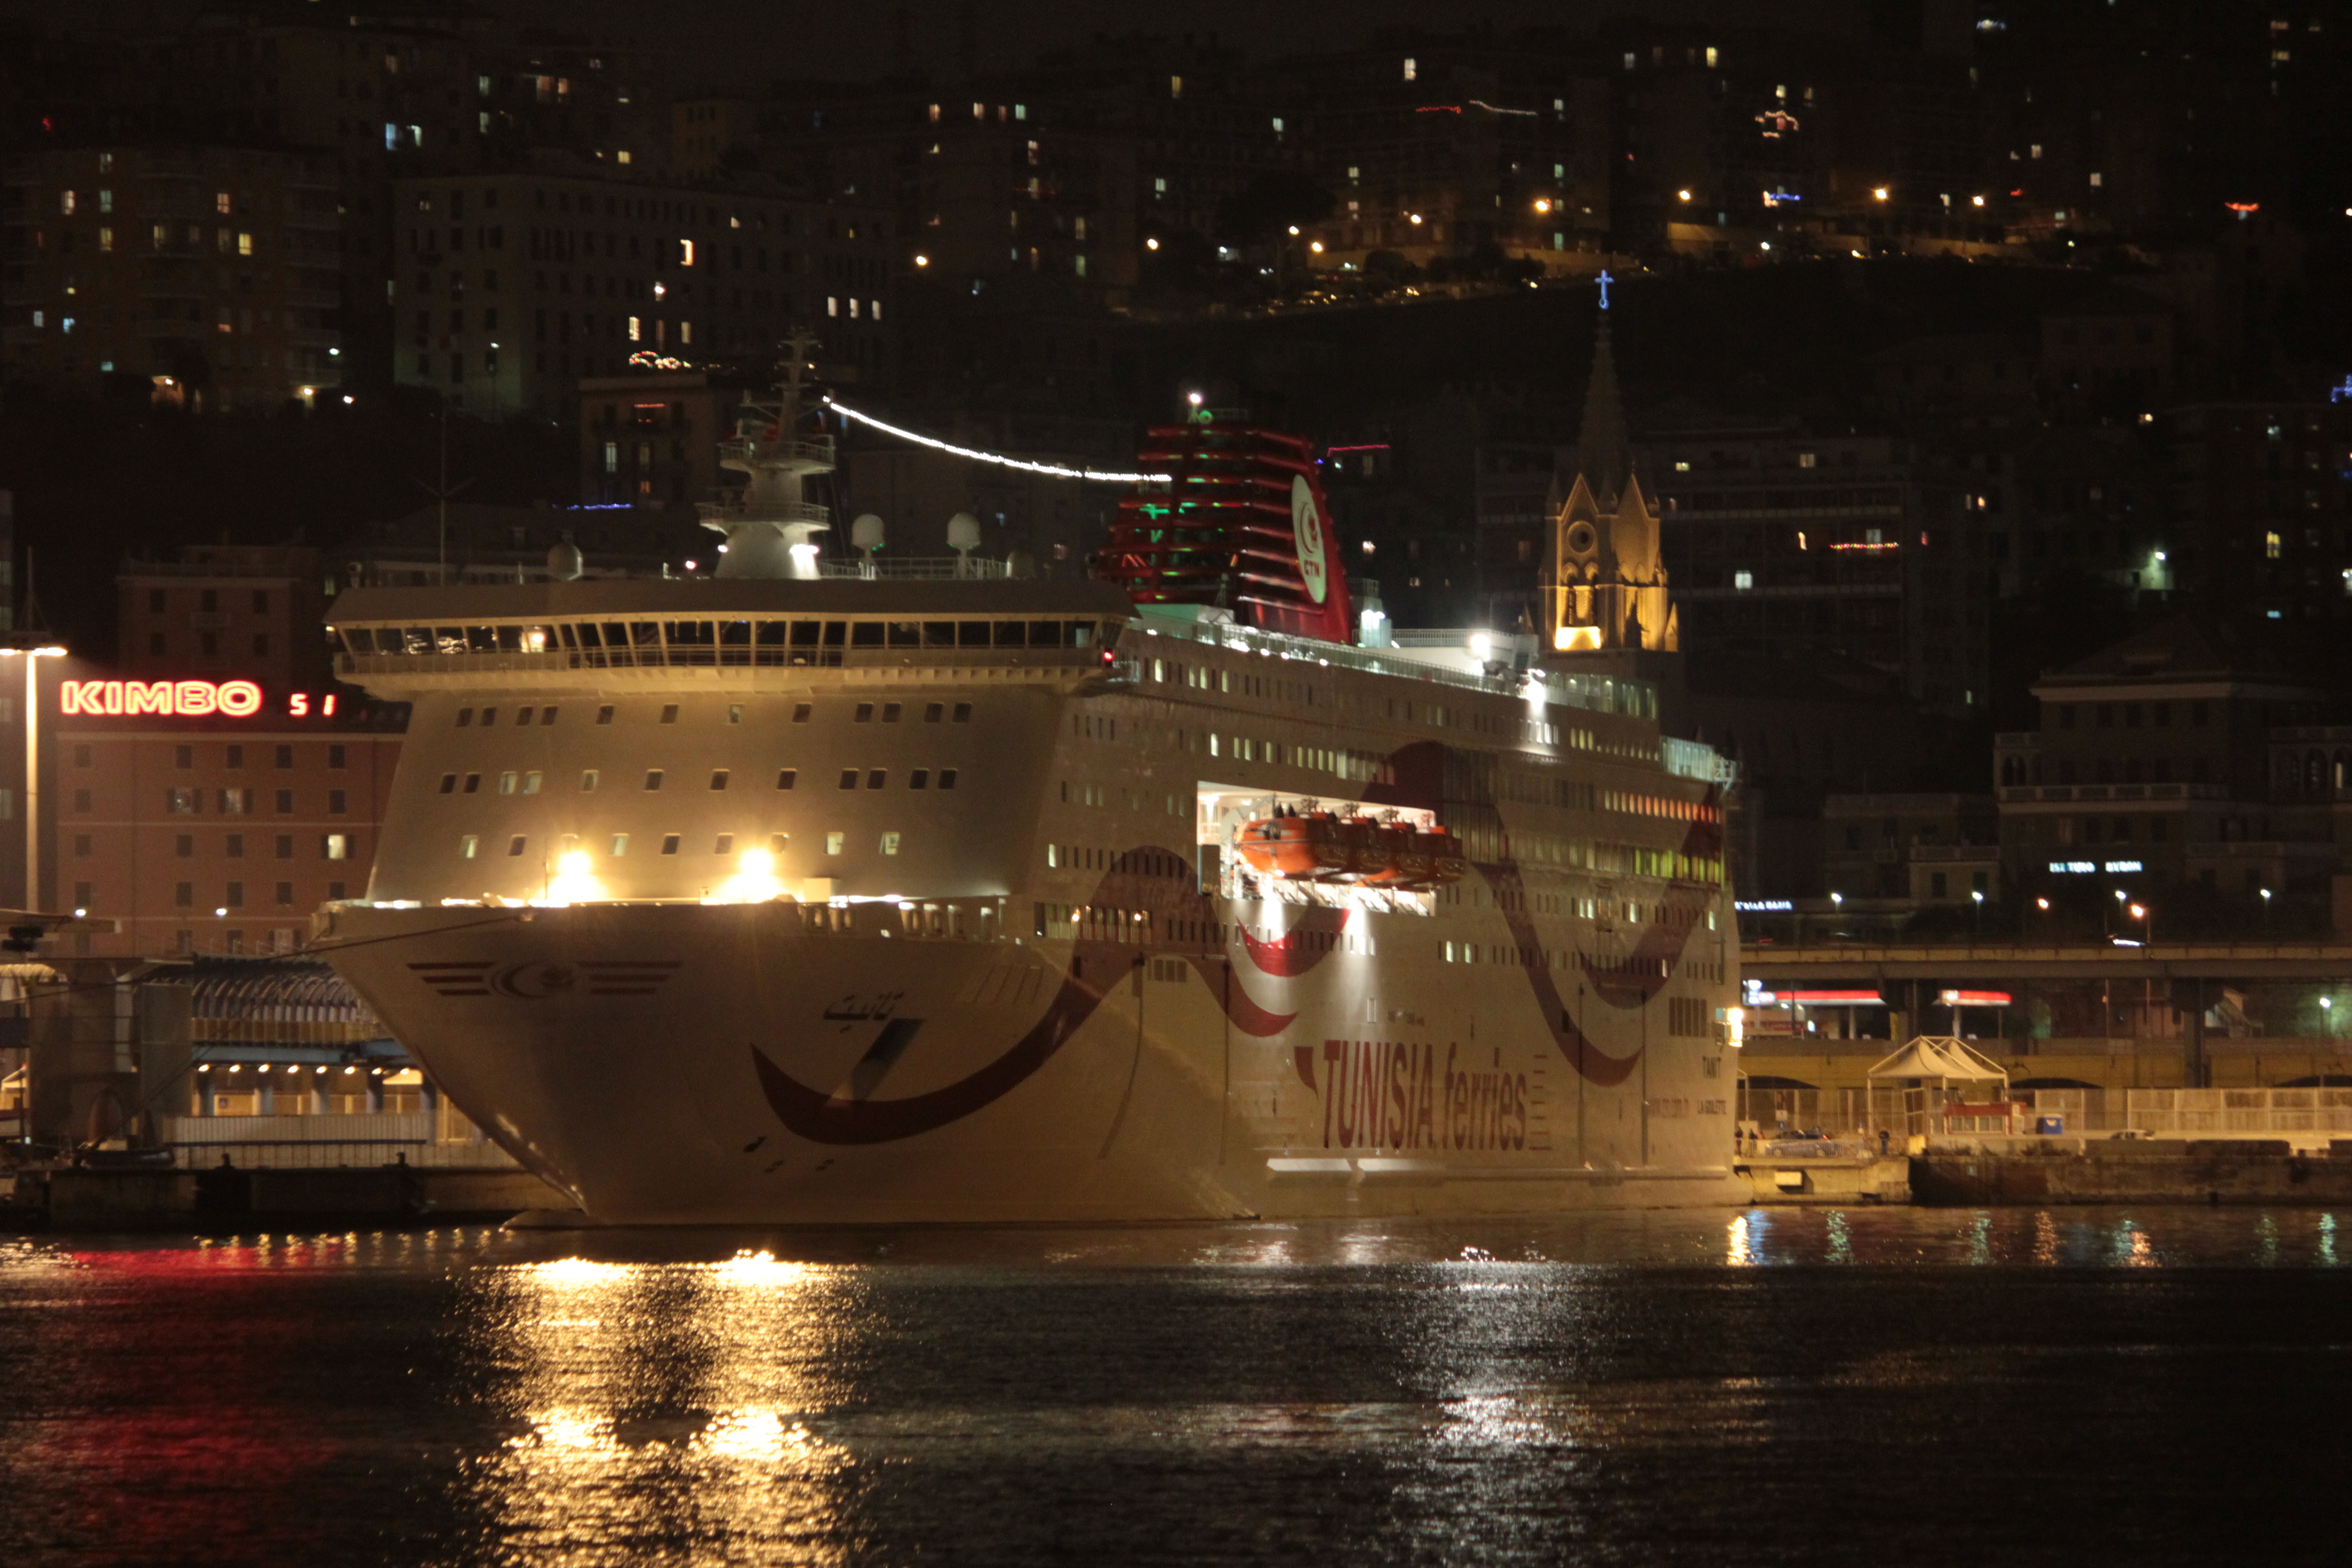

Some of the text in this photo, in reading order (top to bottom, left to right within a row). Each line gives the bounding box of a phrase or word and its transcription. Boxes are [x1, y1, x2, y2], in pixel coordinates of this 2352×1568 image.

[1304, 559, 1320, 578] CTN
[61, 681, 262, 716] KIMBO
[1702, 1056, 1721, 1079] TANIT
[1323, 1039, 1527, 1151] TUNISIA ferries
